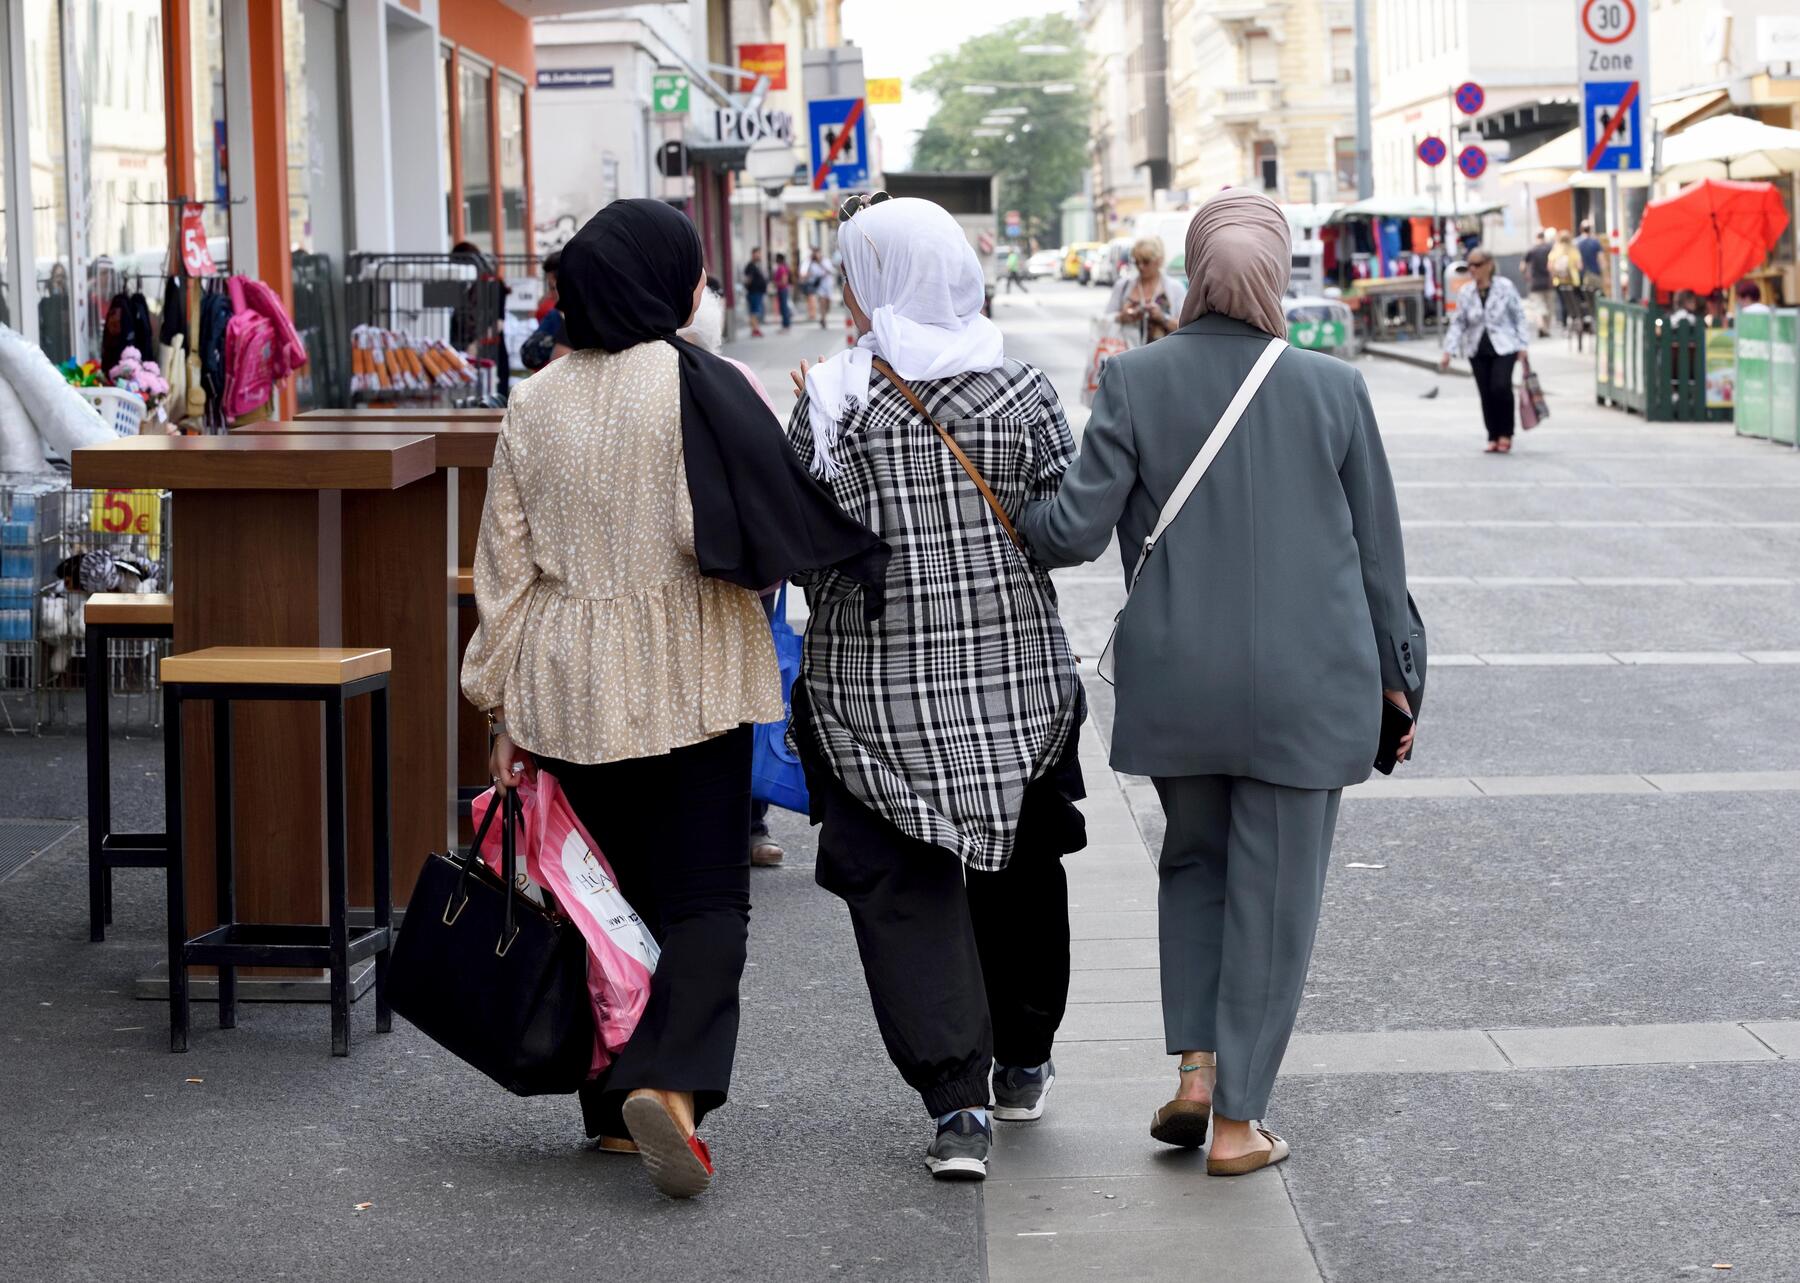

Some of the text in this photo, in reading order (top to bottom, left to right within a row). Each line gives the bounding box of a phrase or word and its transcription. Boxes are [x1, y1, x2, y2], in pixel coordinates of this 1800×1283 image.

[1597, 4, 1621, 30] 30
[1588, 49, 1634, 72] Zone
[101, 488, 151, 533] 5€
